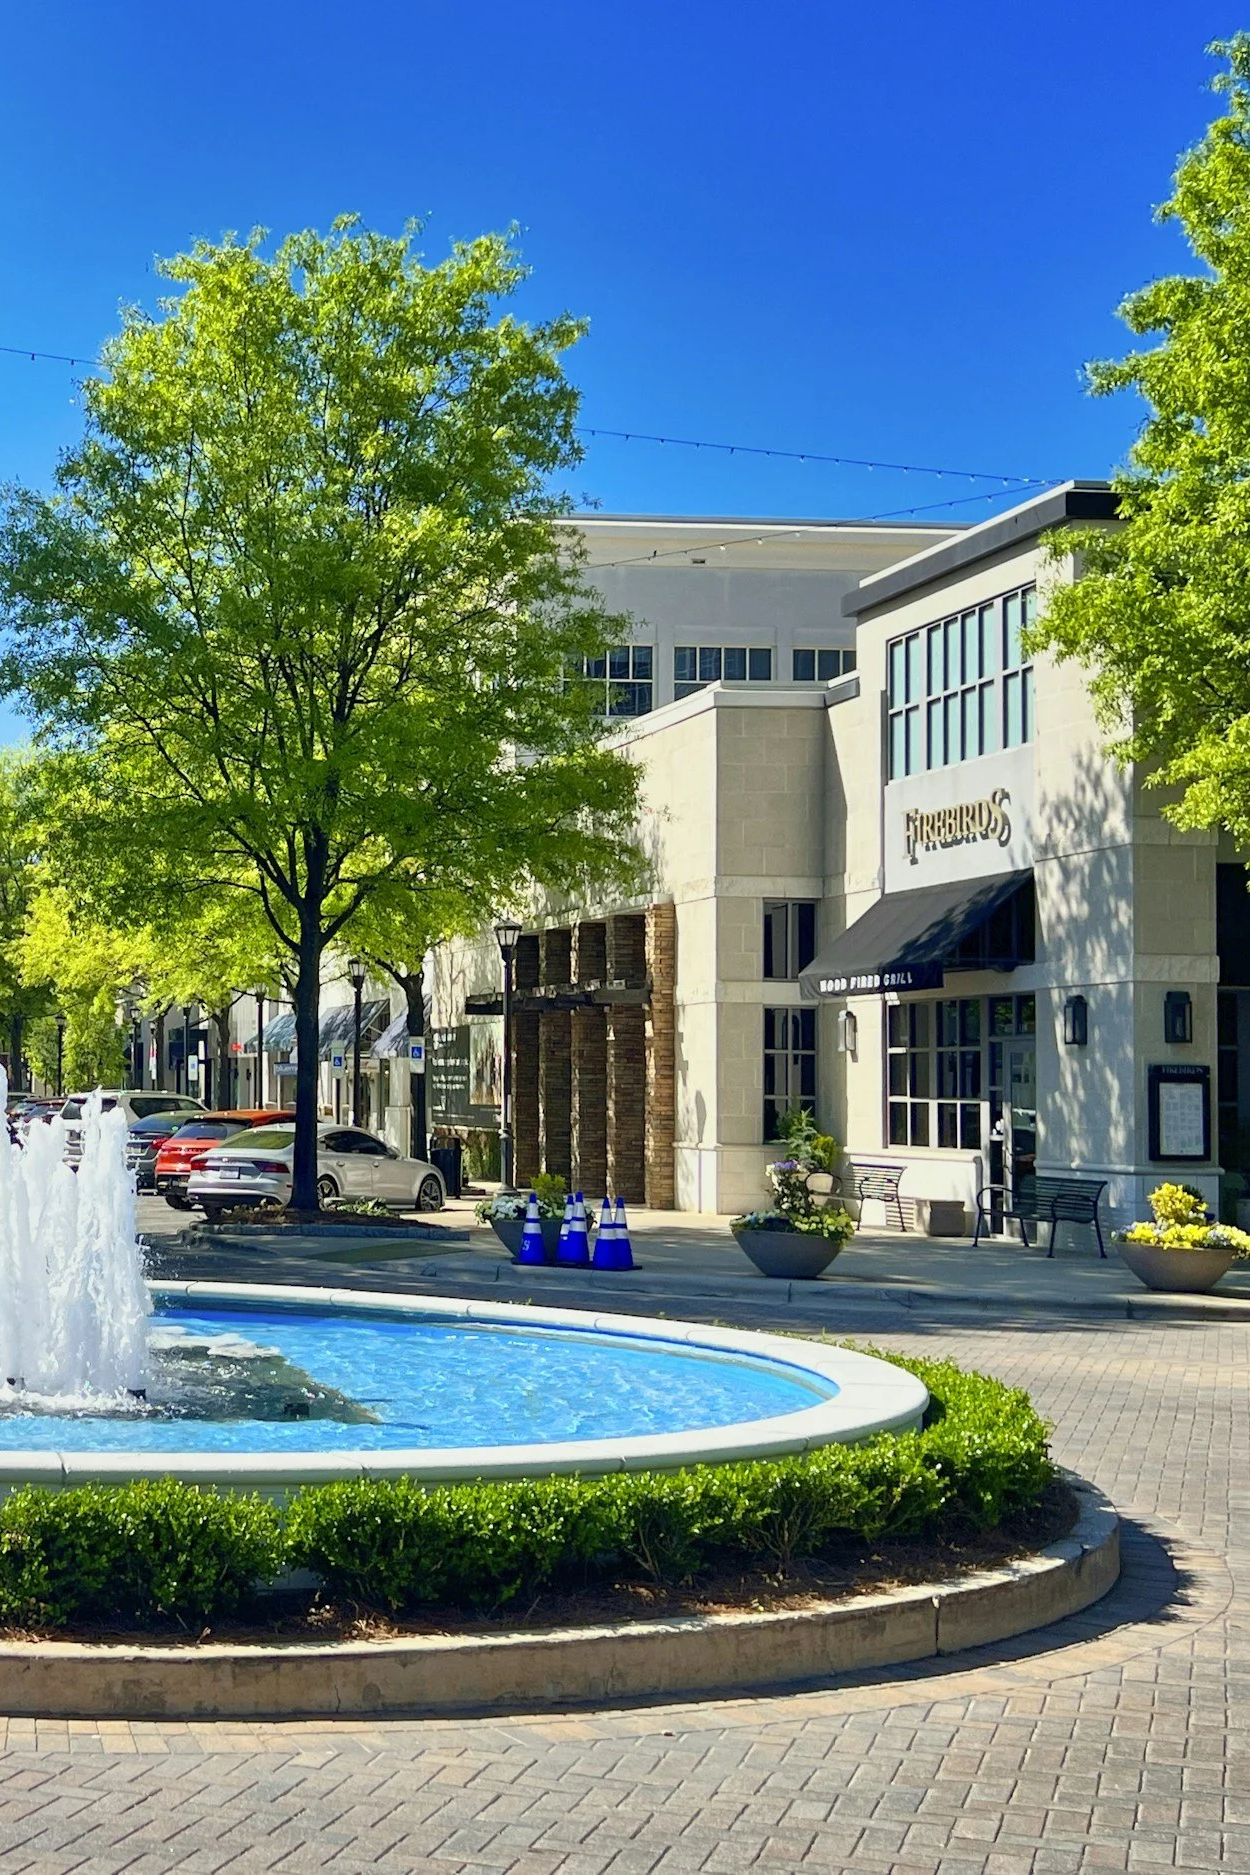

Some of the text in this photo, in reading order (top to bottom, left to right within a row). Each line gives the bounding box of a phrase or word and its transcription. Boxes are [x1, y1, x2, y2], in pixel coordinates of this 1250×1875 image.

[902, 788, 1006, 861] FIREBIRDS
[850, 974, 881, 990] FIRED
[883, 971, 913, 987] GRILL
